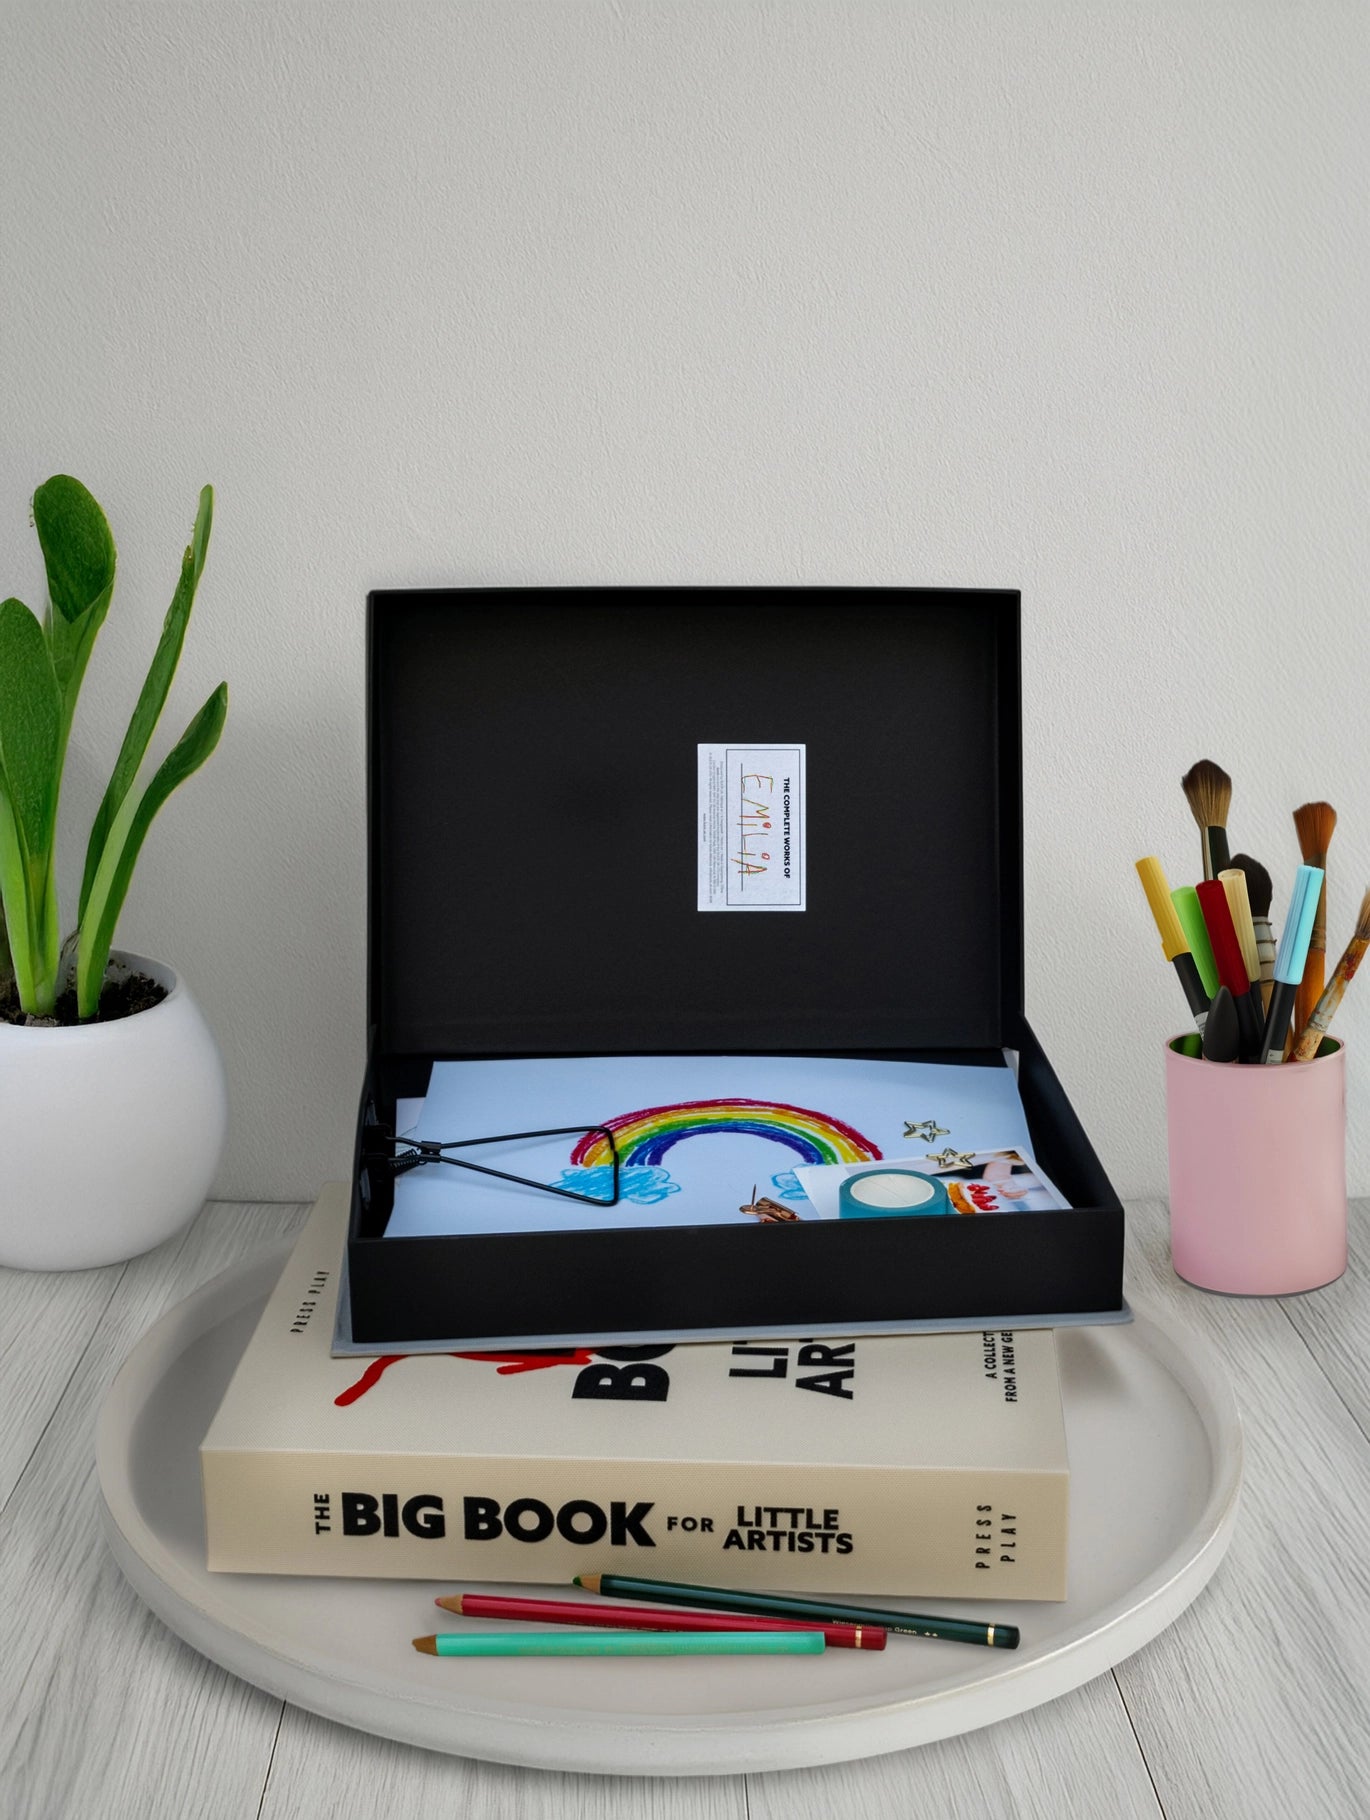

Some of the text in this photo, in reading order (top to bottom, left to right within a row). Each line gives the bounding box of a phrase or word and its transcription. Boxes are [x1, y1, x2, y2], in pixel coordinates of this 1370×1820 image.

[783, 867, 790, 879] OF
[290, 1271, 330, 1333] PRESS PLAY
[1000, 1329, 1013, 1343] GE
[729, 1340, 789, 1378] LI
[795, 1338, 855, 1400] AR
[1001, 1345, 1015, 1366] NEW
[984, 1372, 998, 1380] A
[1003, 1377, 1018, 1402] FROM
[314, 1492, 839, 1547] THE BIG BOOK FOR LITTLE
[723, 1530, 854, 1555] ARTISTS
[975, 1505, 992, 1569] PRESS
[1000, 1514, 1017, 1562] PLAY
